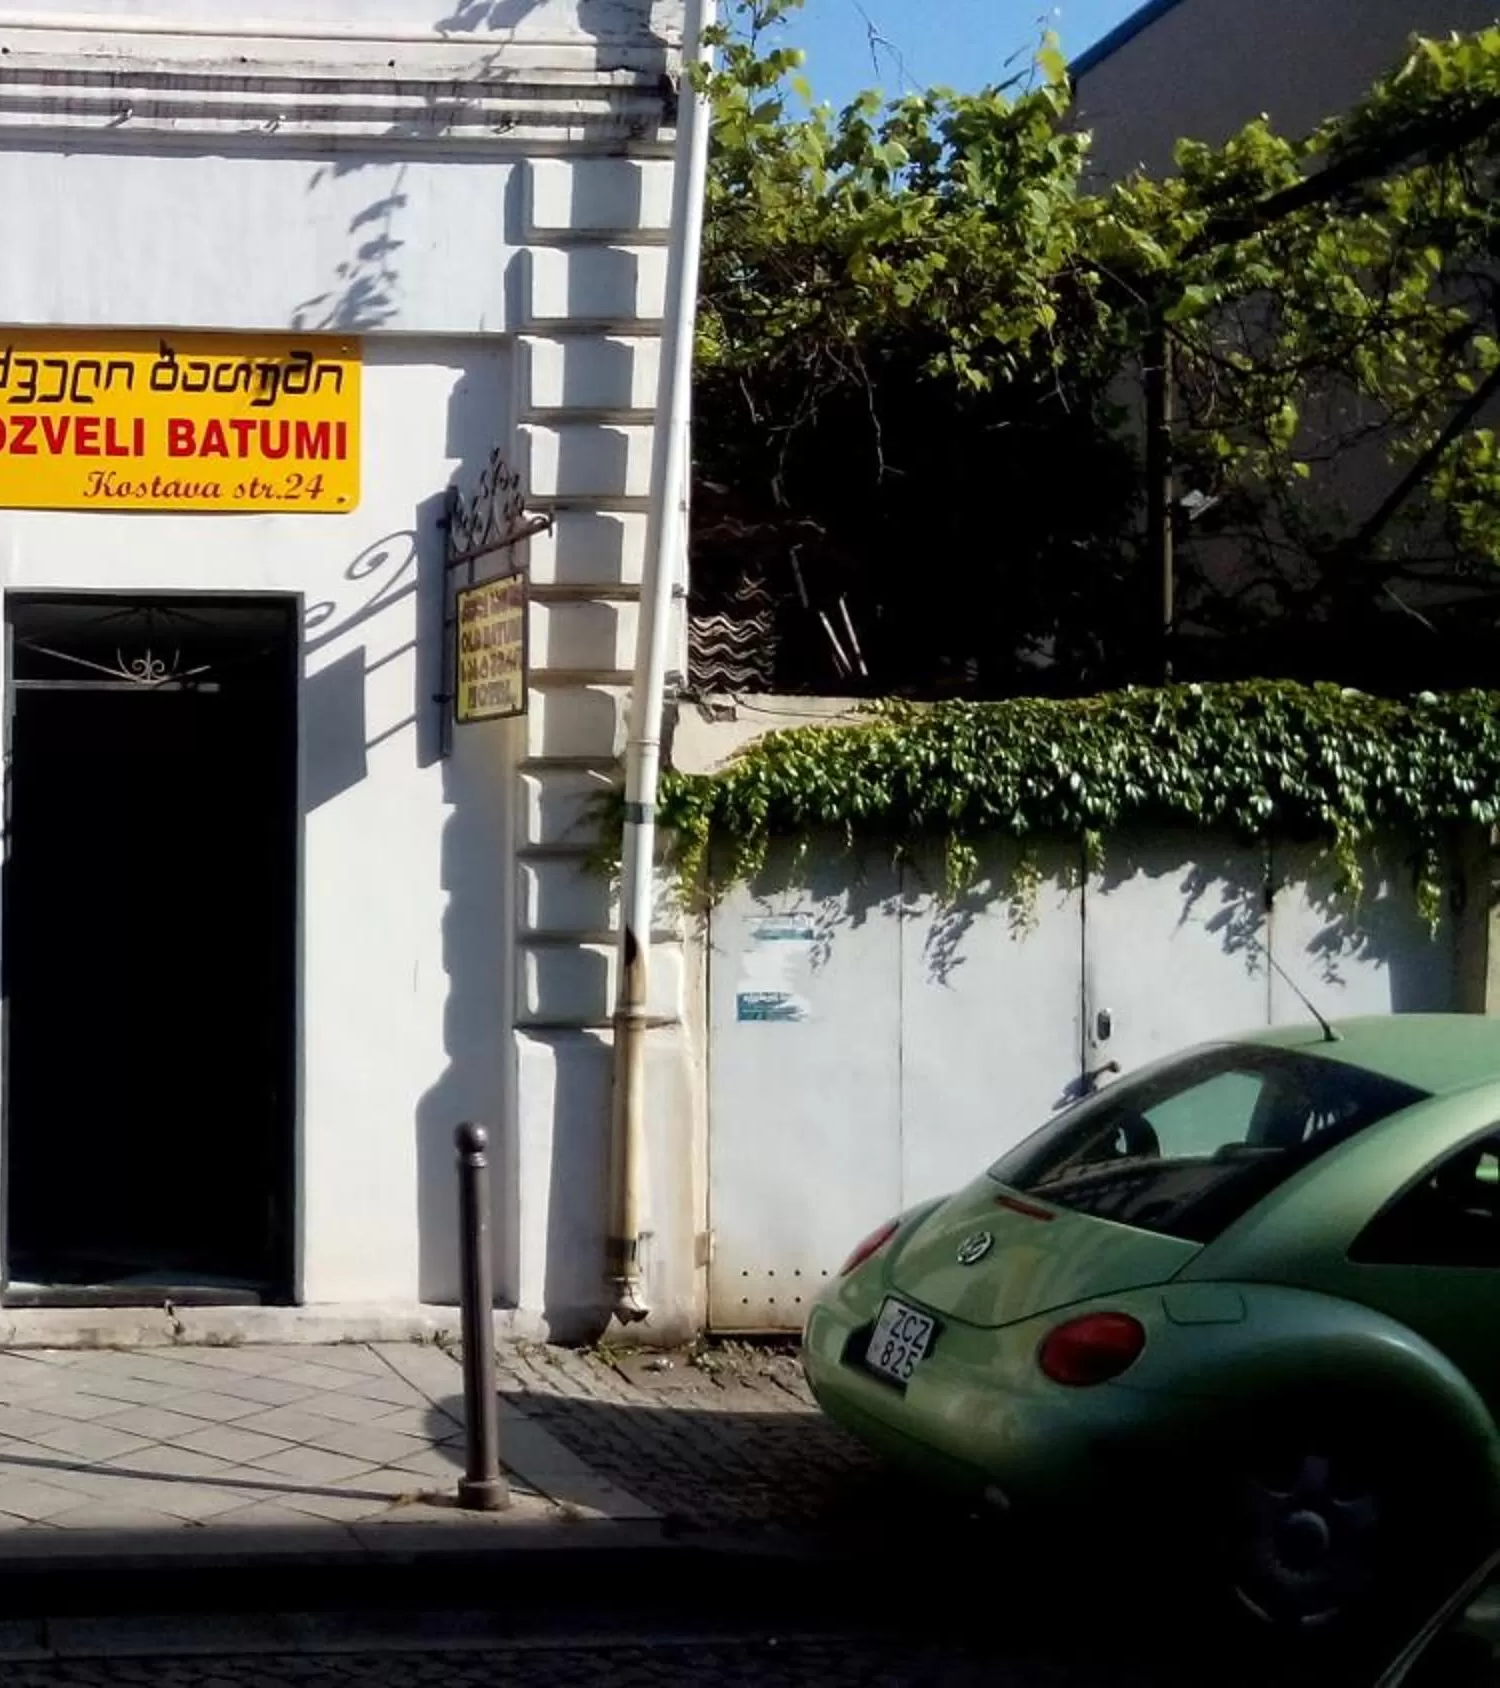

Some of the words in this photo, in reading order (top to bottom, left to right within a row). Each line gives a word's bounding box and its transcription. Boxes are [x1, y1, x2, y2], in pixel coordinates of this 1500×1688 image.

[150, 338, 343, 407] ბათუმი
[167, 420, 347, 460] BATUMI
[83, 470, 221, 499] Kostava
[233, 472, 324, 500] str.24
[890, 1308, 931, 1350] ZCZ
[881, 1340, 918, 1379] 825
